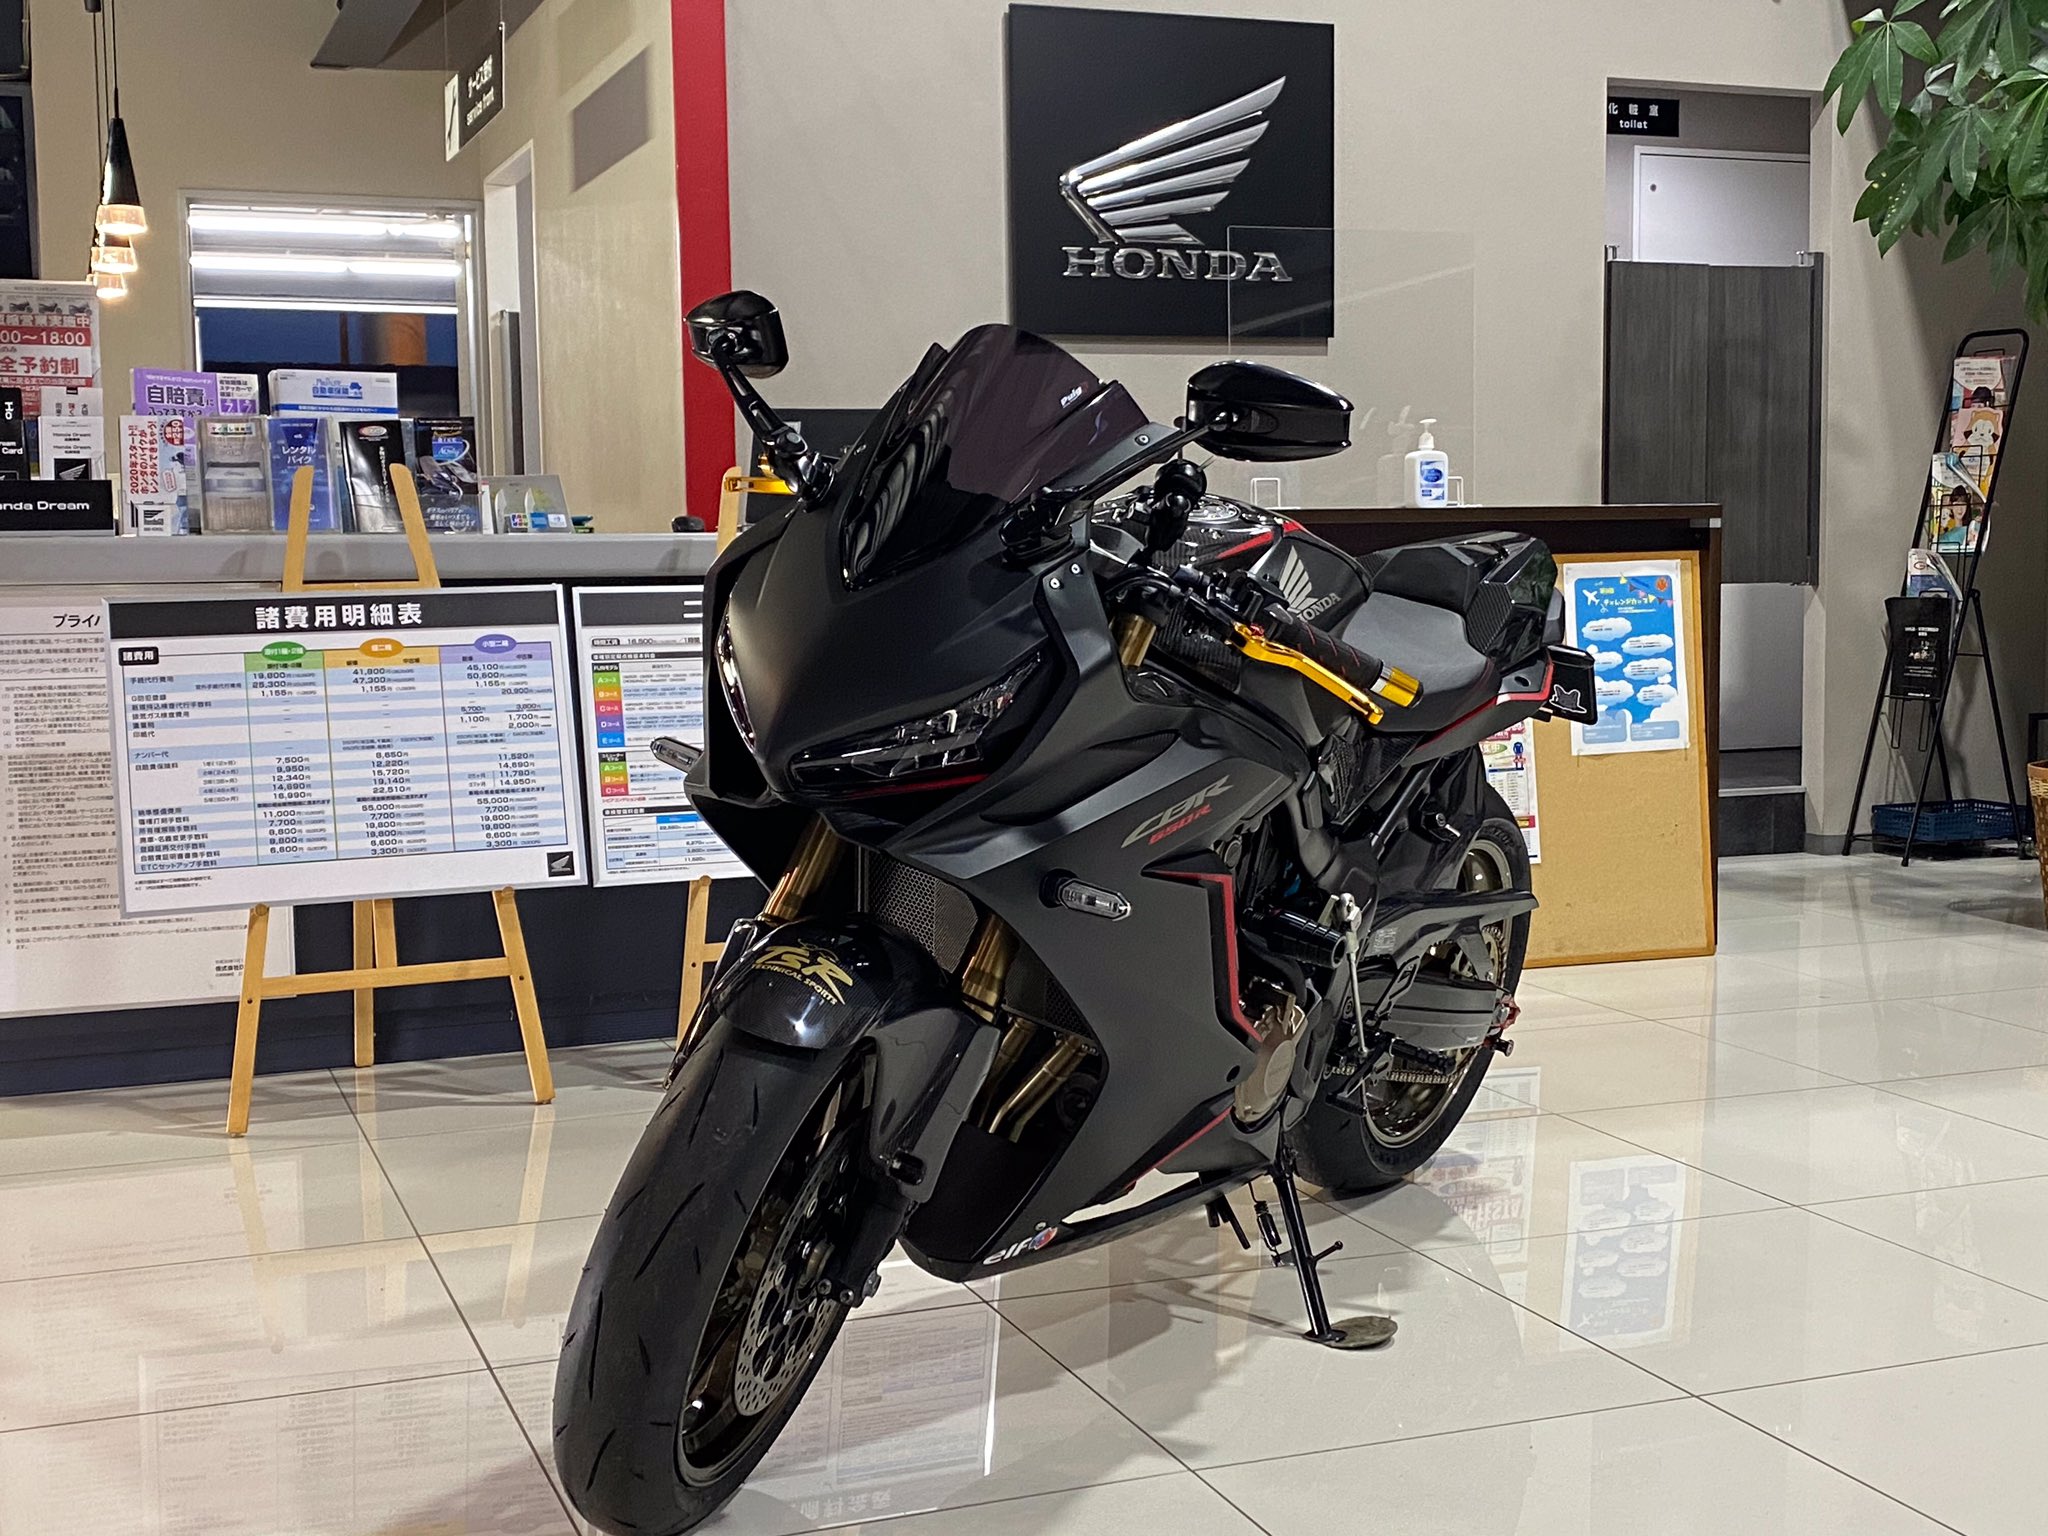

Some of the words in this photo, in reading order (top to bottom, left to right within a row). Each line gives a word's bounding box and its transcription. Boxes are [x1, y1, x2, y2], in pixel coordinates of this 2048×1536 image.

[1608, 102, 1659, 117] 化粧室
[1619, 119, 1648, 129] toilet
[1061, 246, 1293, 282] HONDA
[281, 445, 316, 455] レンタル
[139, 429, 149, 494] ホンダのバイクが
[287, 455, 312, 464] バイク
[37, 501, 90, 510] Dream
[255, 602, 423, 630] 諸費用明細表
[482, 640, 509, 648] 小型二輪
[122, 650, 154, 661] 諸費用
[134, 751, 169, 759] ナンバー代
[1121, 775, 1234, 849] CBR
[1148, 804, 1213, 845] 650R
[751, 963, 803, 982] TECHNICAL
[803, 978, 838, 1005] SPORTS
[983, 1237, 1033, 1265] elf
